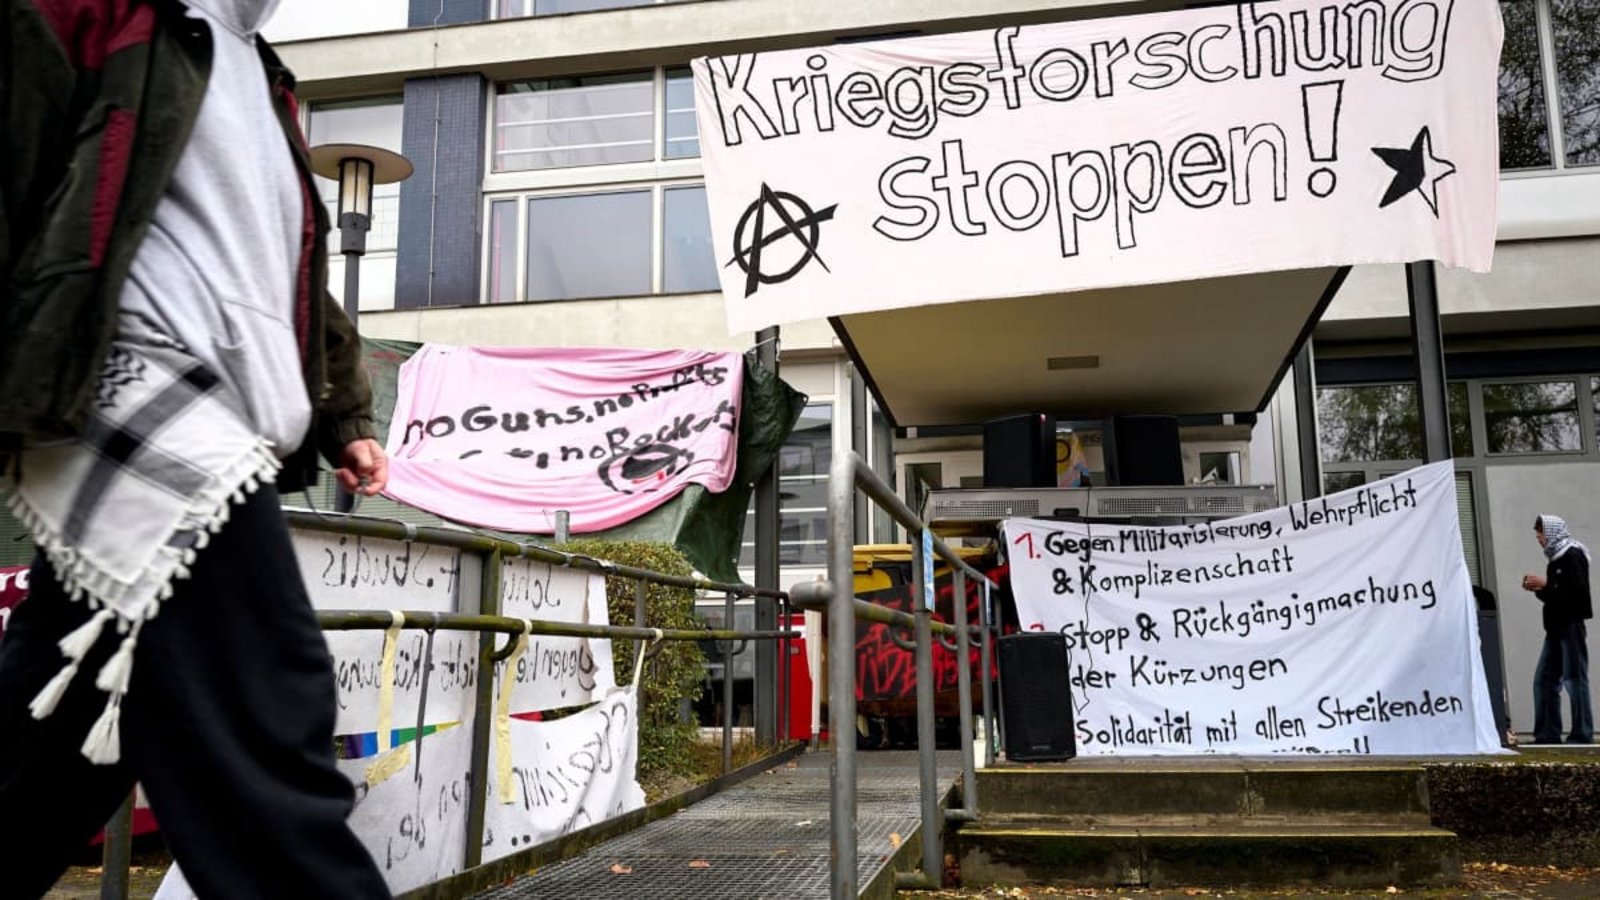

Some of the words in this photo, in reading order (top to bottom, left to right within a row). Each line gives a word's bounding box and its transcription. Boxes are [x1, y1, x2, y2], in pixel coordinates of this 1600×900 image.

[706, 0, 1454, 147] Kriegsforschung
[1014, 532, 1042, 560] 1.
[1044, 531, 1115, 564] Gegen
[1289, 479, 1418, 532] Wehrpflicht
[1053, 568, 1074, 596] &
[1080, 545, 1295, 598] Komplizenschaft
[1061, 620, 1130, 655] Stopp
[1138, 613, 1160, 643] &
[1174, 576, 1437, 639] Rückgängigmachung
[1071, 664, 1117, 689] der
[1130, 655, 1288, 691] Kürzungen
[1076, 708, 1193, 747] Solidarität
[1206, 709, 1238, 747] mit
[1255, 705, 1307, 740] allen
[1317, 690, 1464, 730] Streikenden
